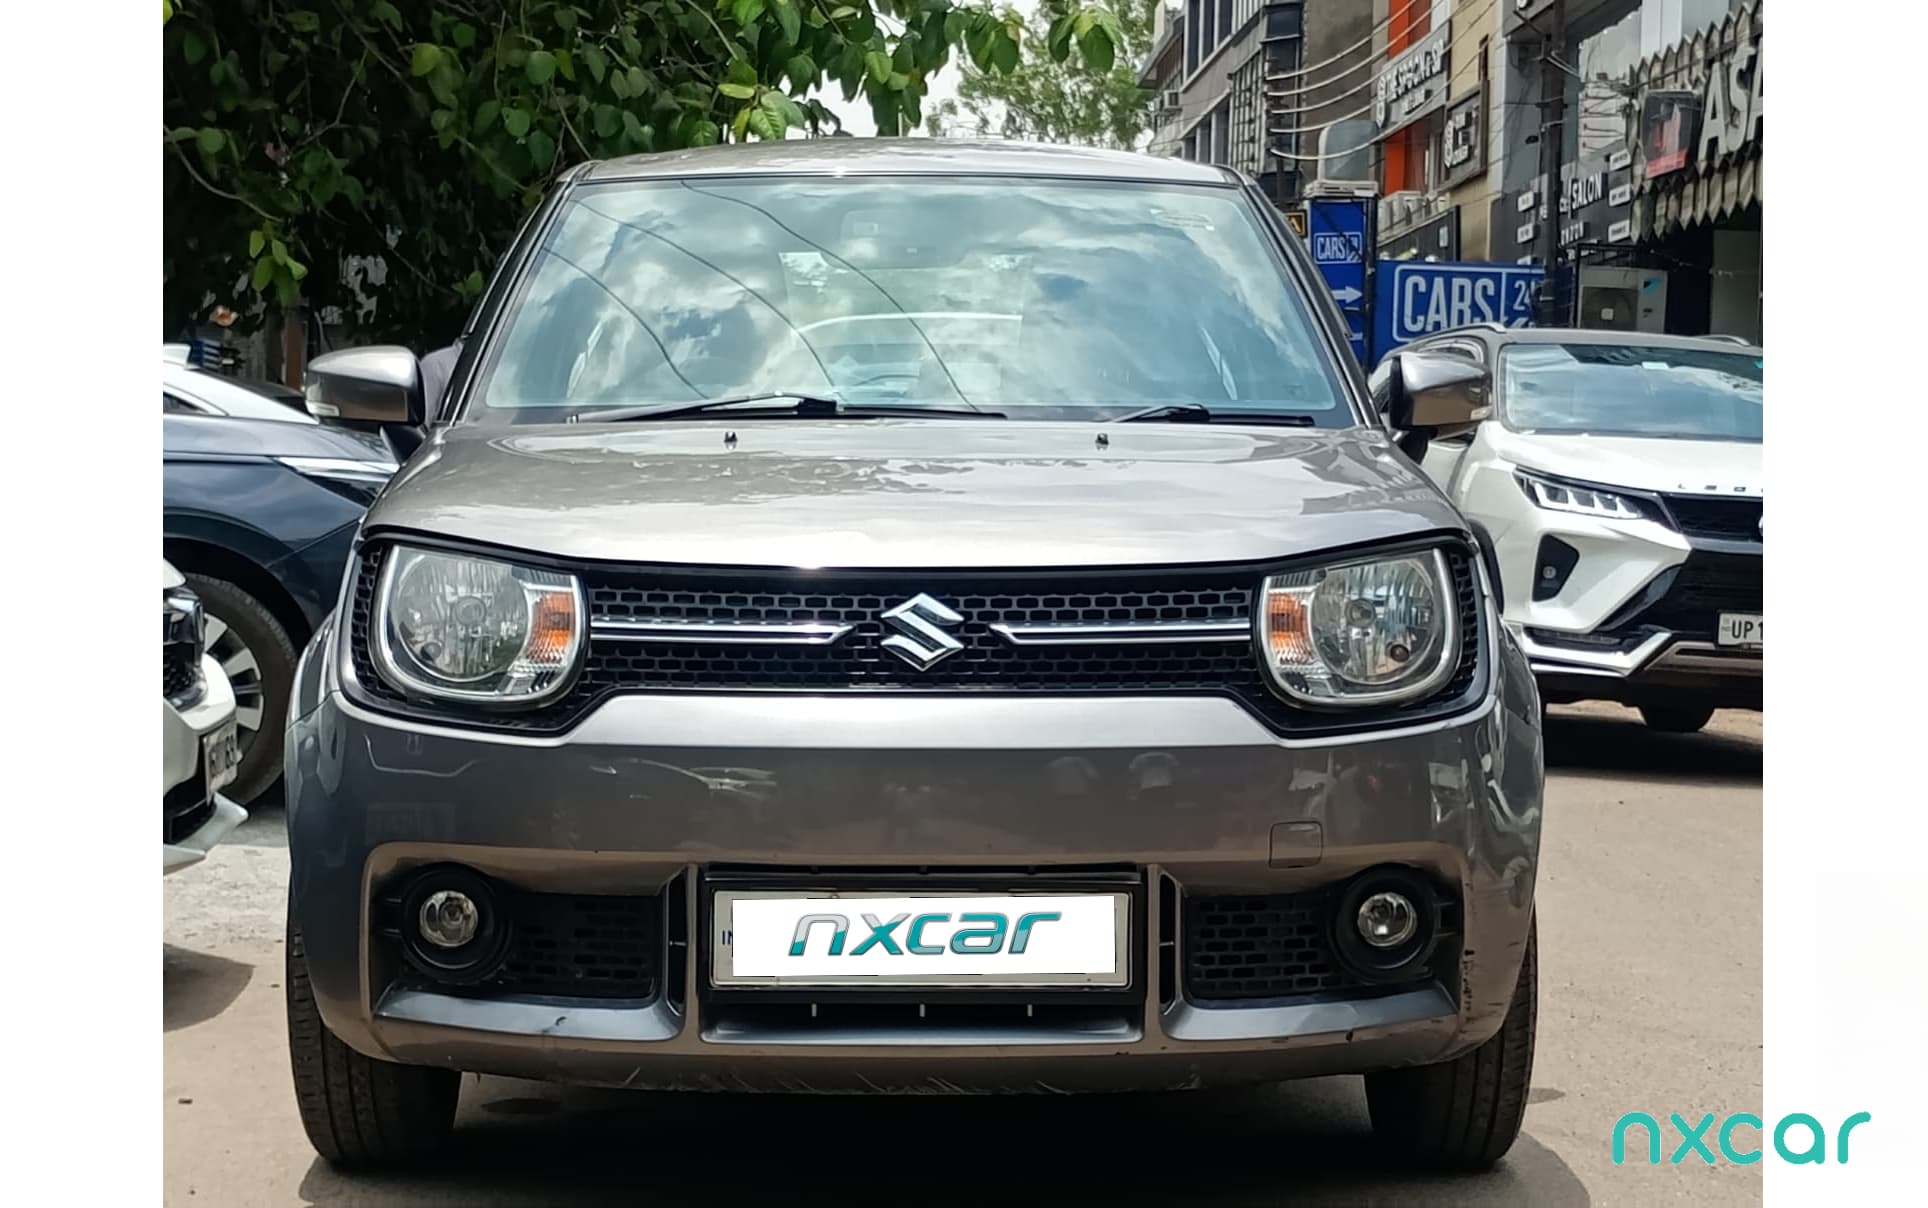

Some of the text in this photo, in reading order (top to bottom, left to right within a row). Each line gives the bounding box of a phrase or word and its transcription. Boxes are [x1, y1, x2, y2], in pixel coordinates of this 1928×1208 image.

[1572, 169, 1602, 210] SALON
[1317, 235, 1346, 260] CARS
[1403, 275, 1495, 333] CARS
[1731, 620, 1754, 640] UP
